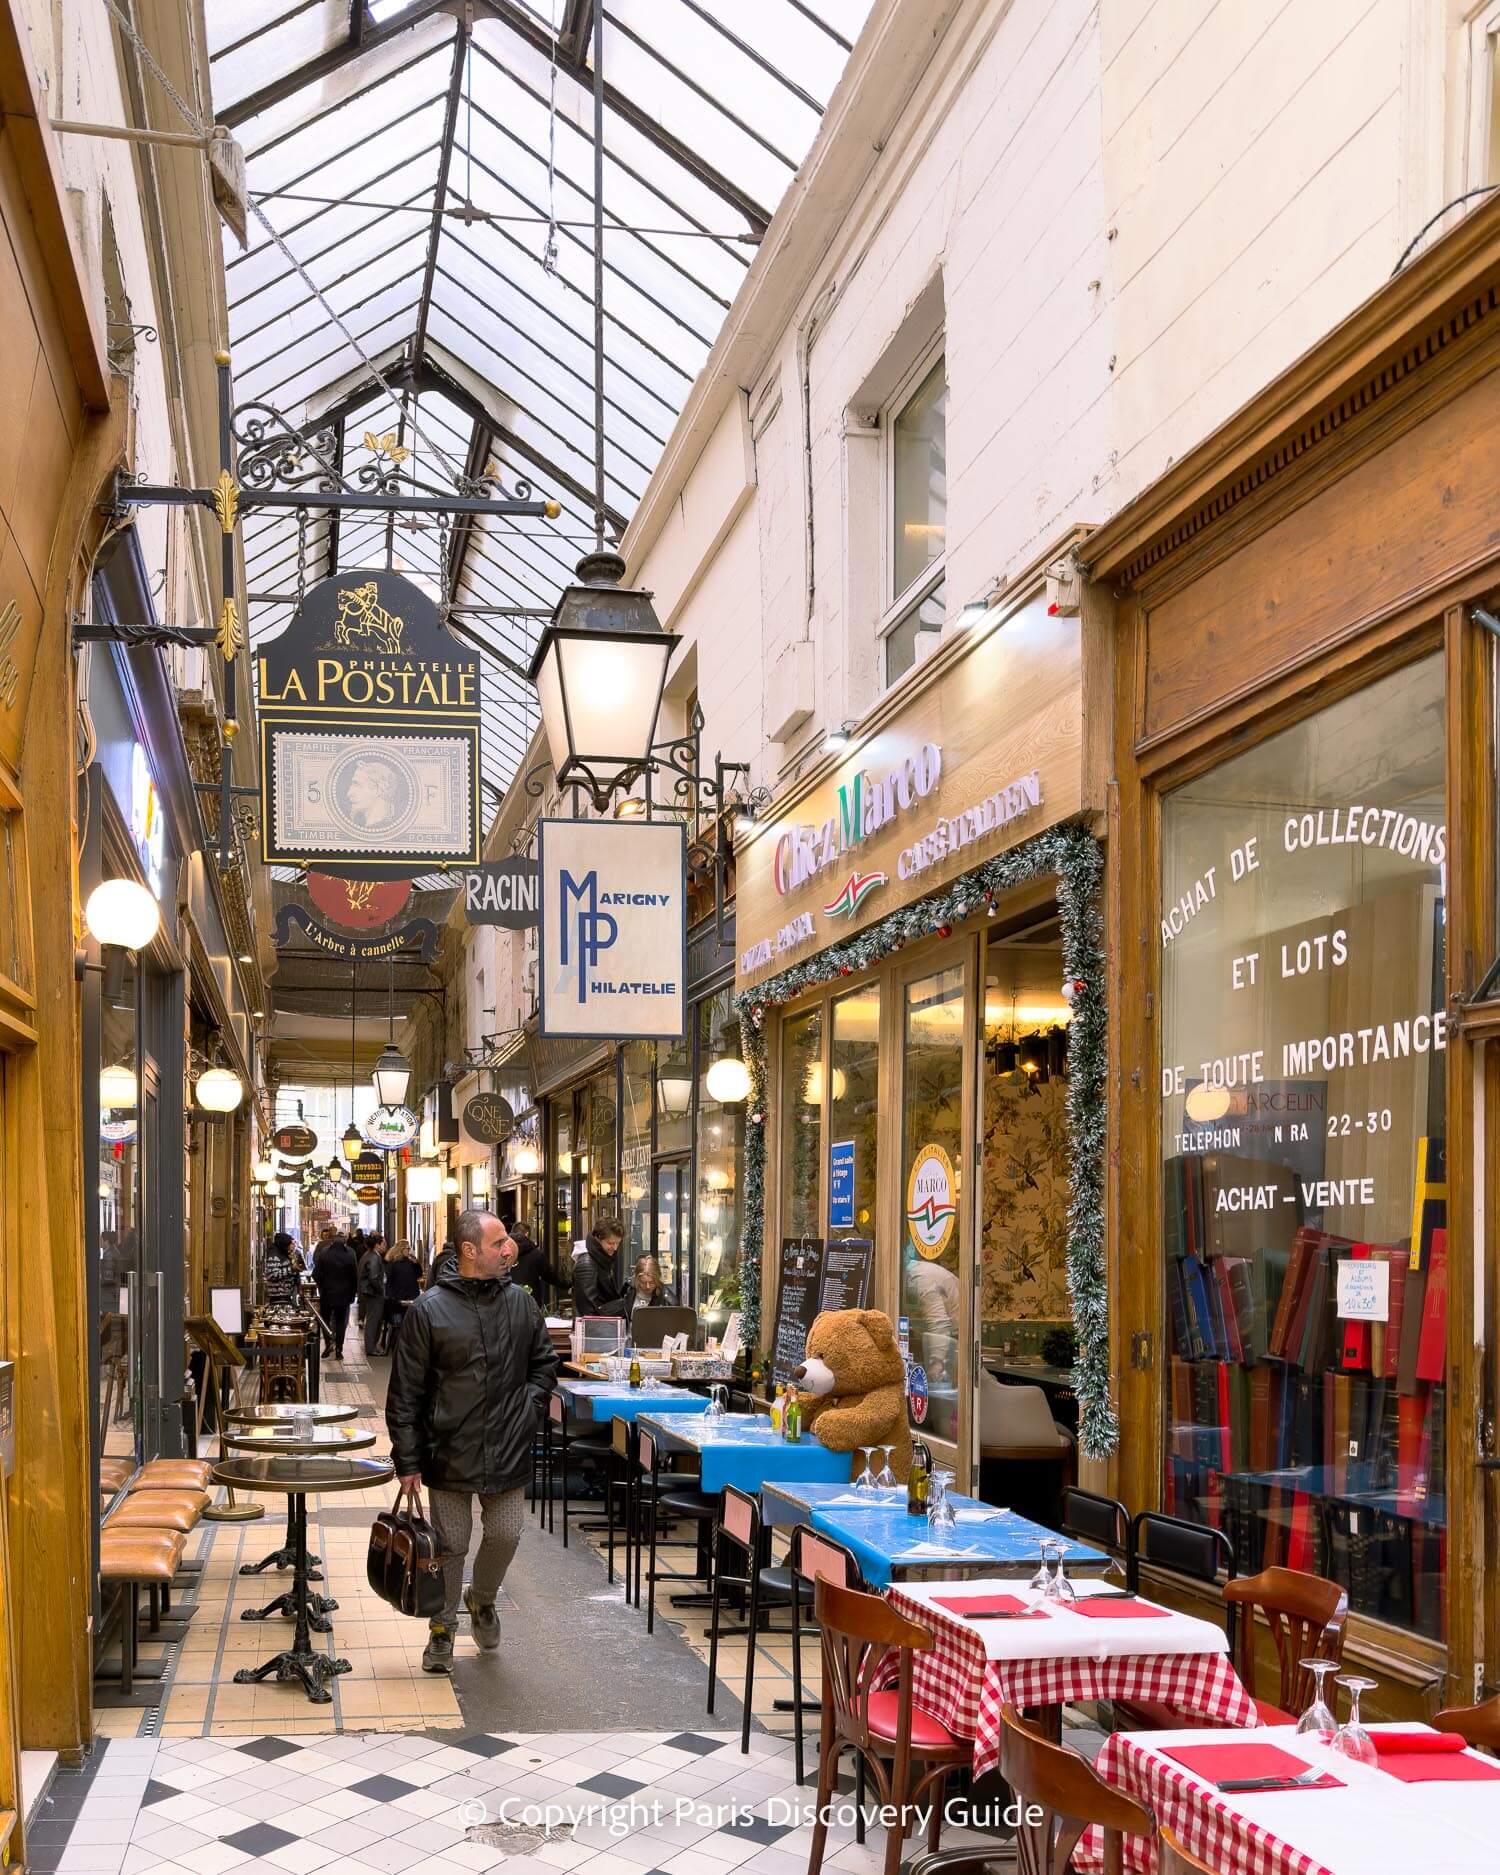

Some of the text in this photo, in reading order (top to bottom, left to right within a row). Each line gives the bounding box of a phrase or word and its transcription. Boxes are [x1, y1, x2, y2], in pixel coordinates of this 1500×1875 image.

[258, 657, 476, 705] LA POSTALE
[350, 660, 475, 673] PHILATELIE
[296, 743, 337, 752] EMPIRE
[307, 781, 439, 807] 5 F
[948, 768, 1041, 852] ITALIEN
[299, 830, 448, 843] TIMBRE POSTE
[774, 743, 943, 896] Chez Marco
[1161, 806, 1446, 948] ACHAT DE COLLECTIONS
[560, 870, 670, 965] MARIGNY
[304, 922, 405, 957] L'Arbre à cannelle
[1232, 929, 1349, 990] ET LOTS
[1162, 1010, 1446, 1098] DE TOUTE IMPORTANCE
[1327, 1109, 1392, 1138] 22-30
[916, 1177, 947, 1194] MARCO
[1215, 1184, 1278, 1213] ACHAT
[1301, 1177, 1375, 1208] VENTE
